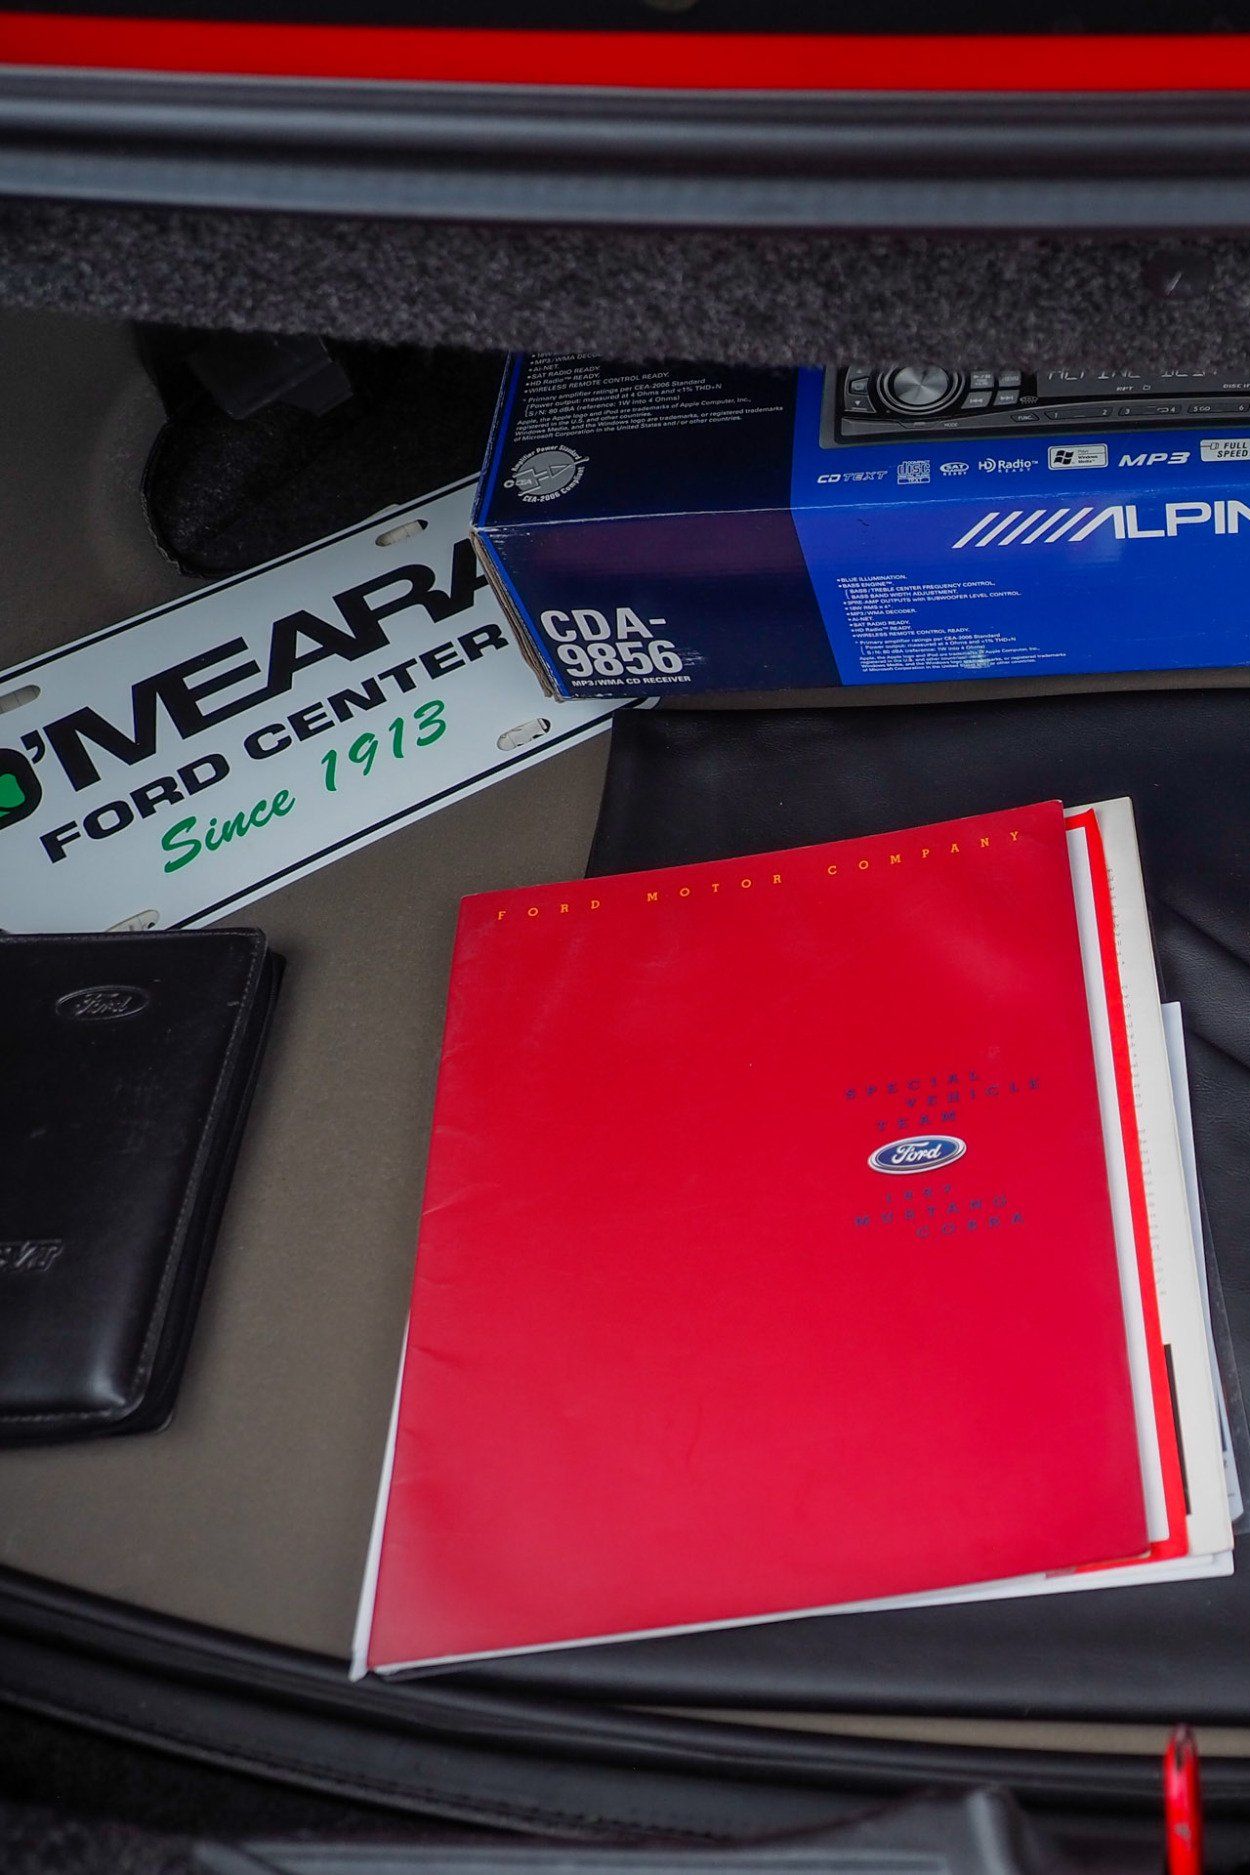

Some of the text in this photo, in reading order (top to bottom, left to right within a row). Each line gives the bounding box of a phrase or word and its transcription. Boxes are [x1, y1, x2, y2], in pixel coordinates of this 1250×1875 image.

[1216, 449, 1248, 458] SPEED
[1223, 442, 1248, 450] FULL
[1118, 452, 1190, 467] MP3
[540, 607, 666, 642] CDA-
[557, 640, 683, 677] 9856
[572, 678, 624, 687] MP3/WMA
[643, 675, 691, 684] RECEIVER
[40, 623, 509, 864] FORD CENTER
[162, 700, 447, 873] Since 1913
[497, 830, 1020, 920] FORD MOTOR COMPANY
[75, 993, 132, 1017] Ford
[846, 1071, 979, 1100] SPECIAL
[907, 1079, 1040, 1107] VEHICLE
[877, 1111, 956, 1131] TEAM
[891, 1141, 942, 1164] Ford
